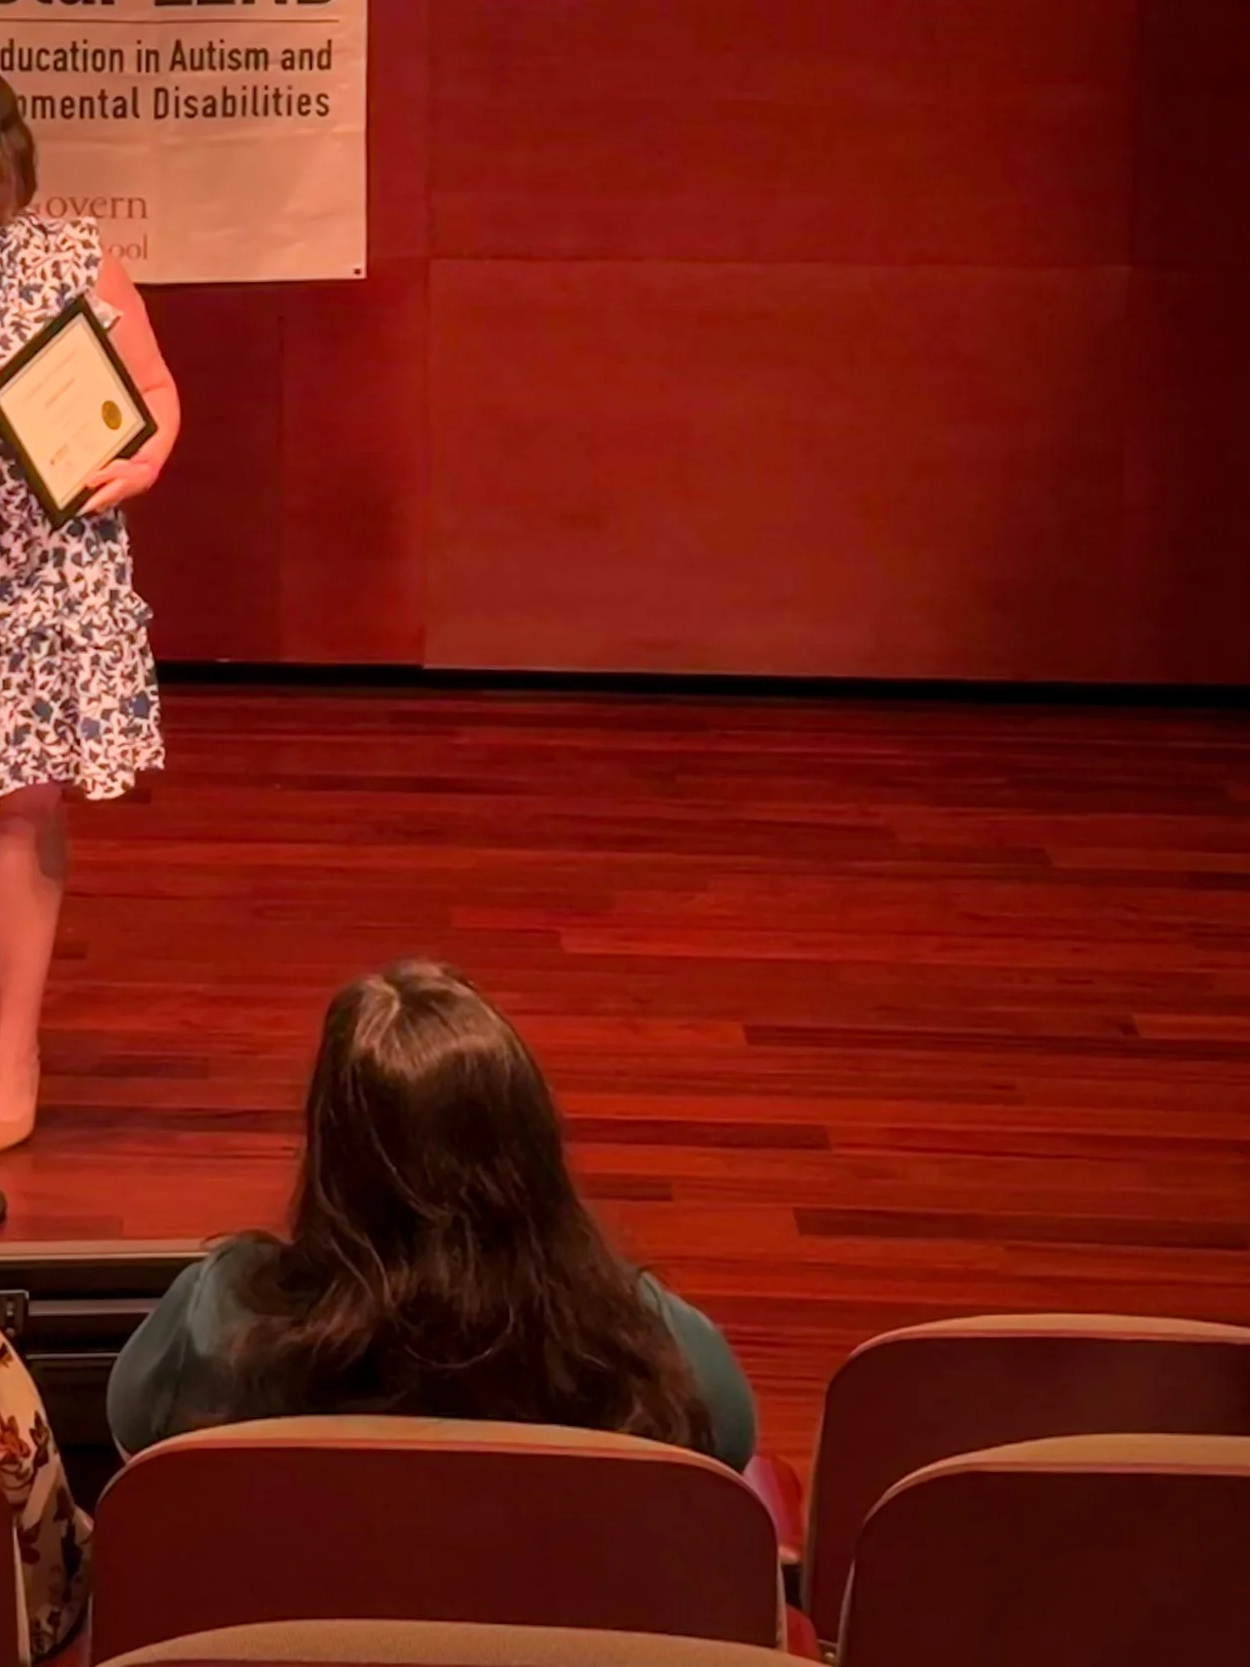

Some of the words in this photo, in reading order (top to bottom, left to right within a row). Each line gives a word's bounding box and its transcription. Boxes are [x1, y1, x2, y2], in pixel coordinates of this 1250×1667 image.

[136, 40, 160, 73] in
[169, 39, 269, 72] Autism
[280, 39, 332, 71] and
[154, 85, 330, 120] Disabilities
